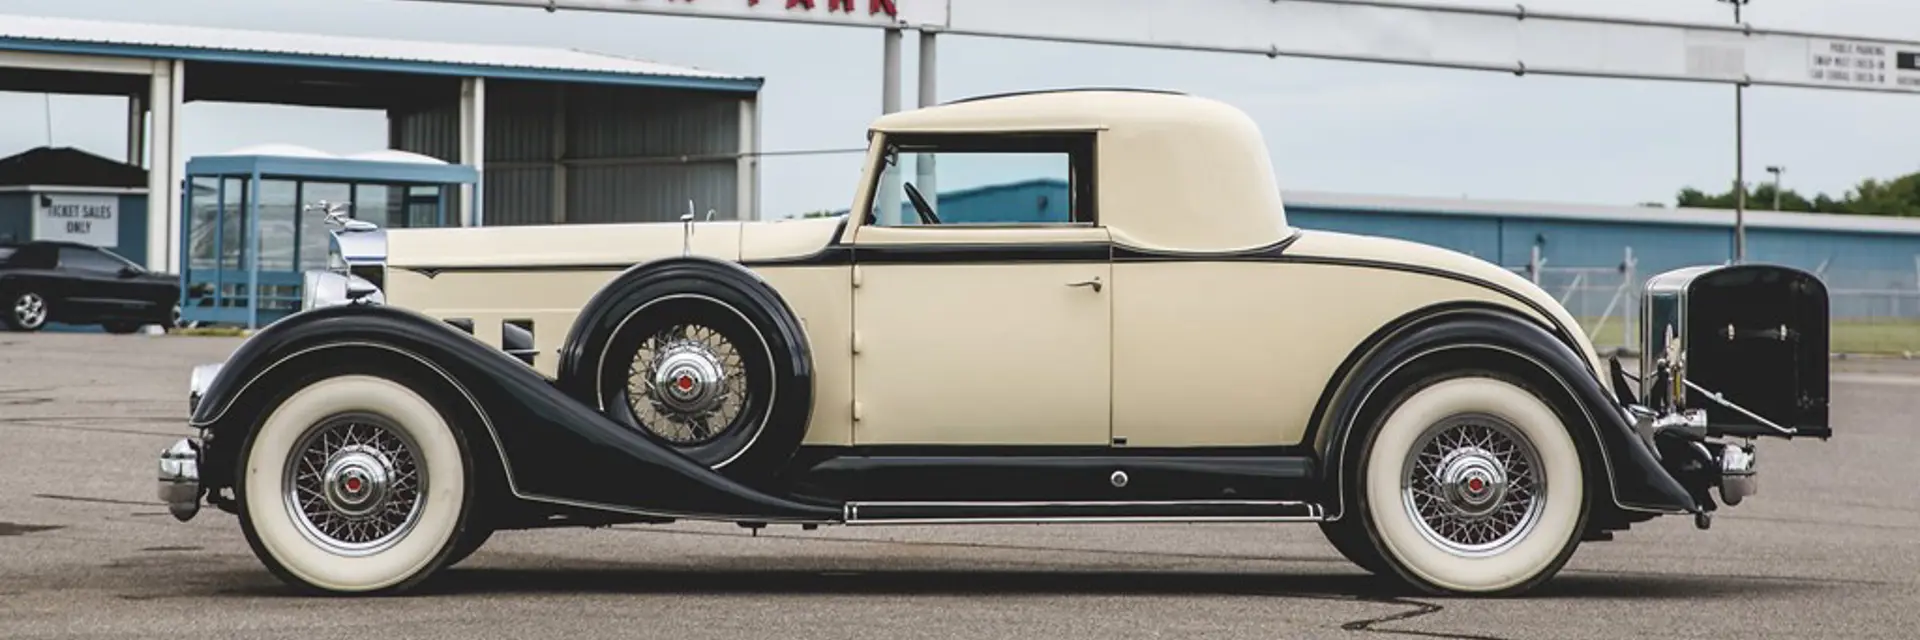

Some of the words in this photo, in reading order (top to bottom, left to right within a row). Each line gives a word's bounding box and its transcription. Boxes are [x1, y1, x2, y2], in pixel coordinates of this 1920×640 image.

[47, 204, 80, 218] TICKET
[82, 205, 112, 219] SALES
[66, 220, 92, 234] ONLY
